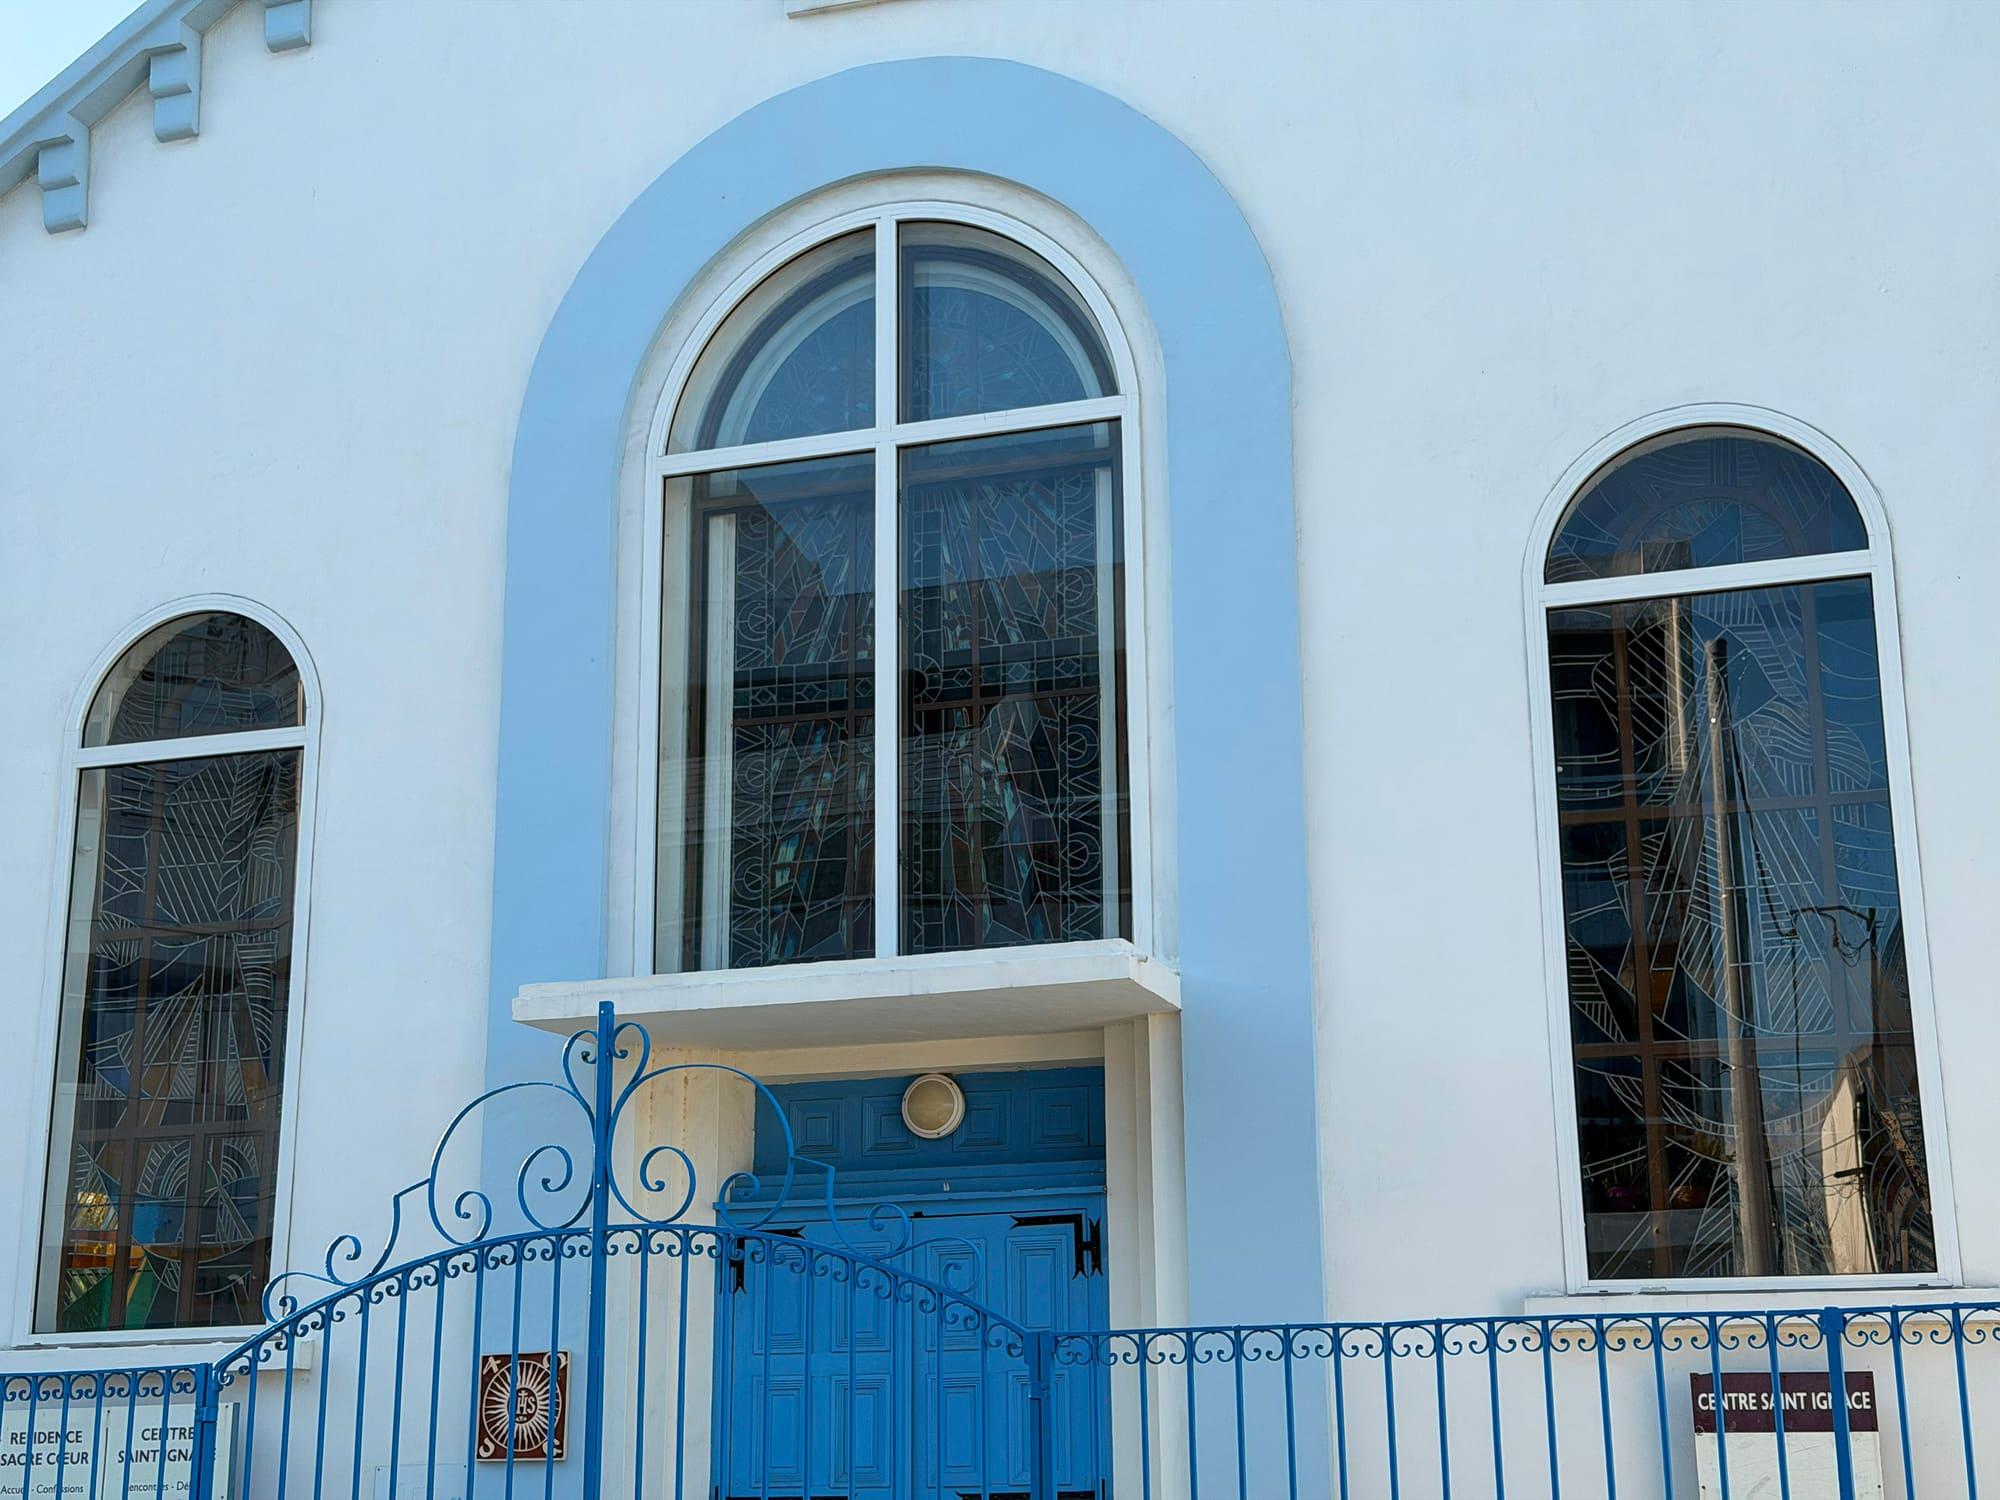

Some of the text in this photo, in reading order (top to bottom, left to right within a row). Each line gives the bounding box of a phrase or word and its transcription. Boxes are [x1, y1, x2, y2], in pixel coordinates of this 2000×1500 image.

[1698, 1392, 1757, 1411] CENTRE
[1761, 1392, 1807, 1410] SAINT
[10, 1430, 83, 1445] REIDENCE
[117, 1449, 160, 1463] SINT
[36, 1484, 84, 1494] Confssions
[126, 1482, 169, 1492] encontes
